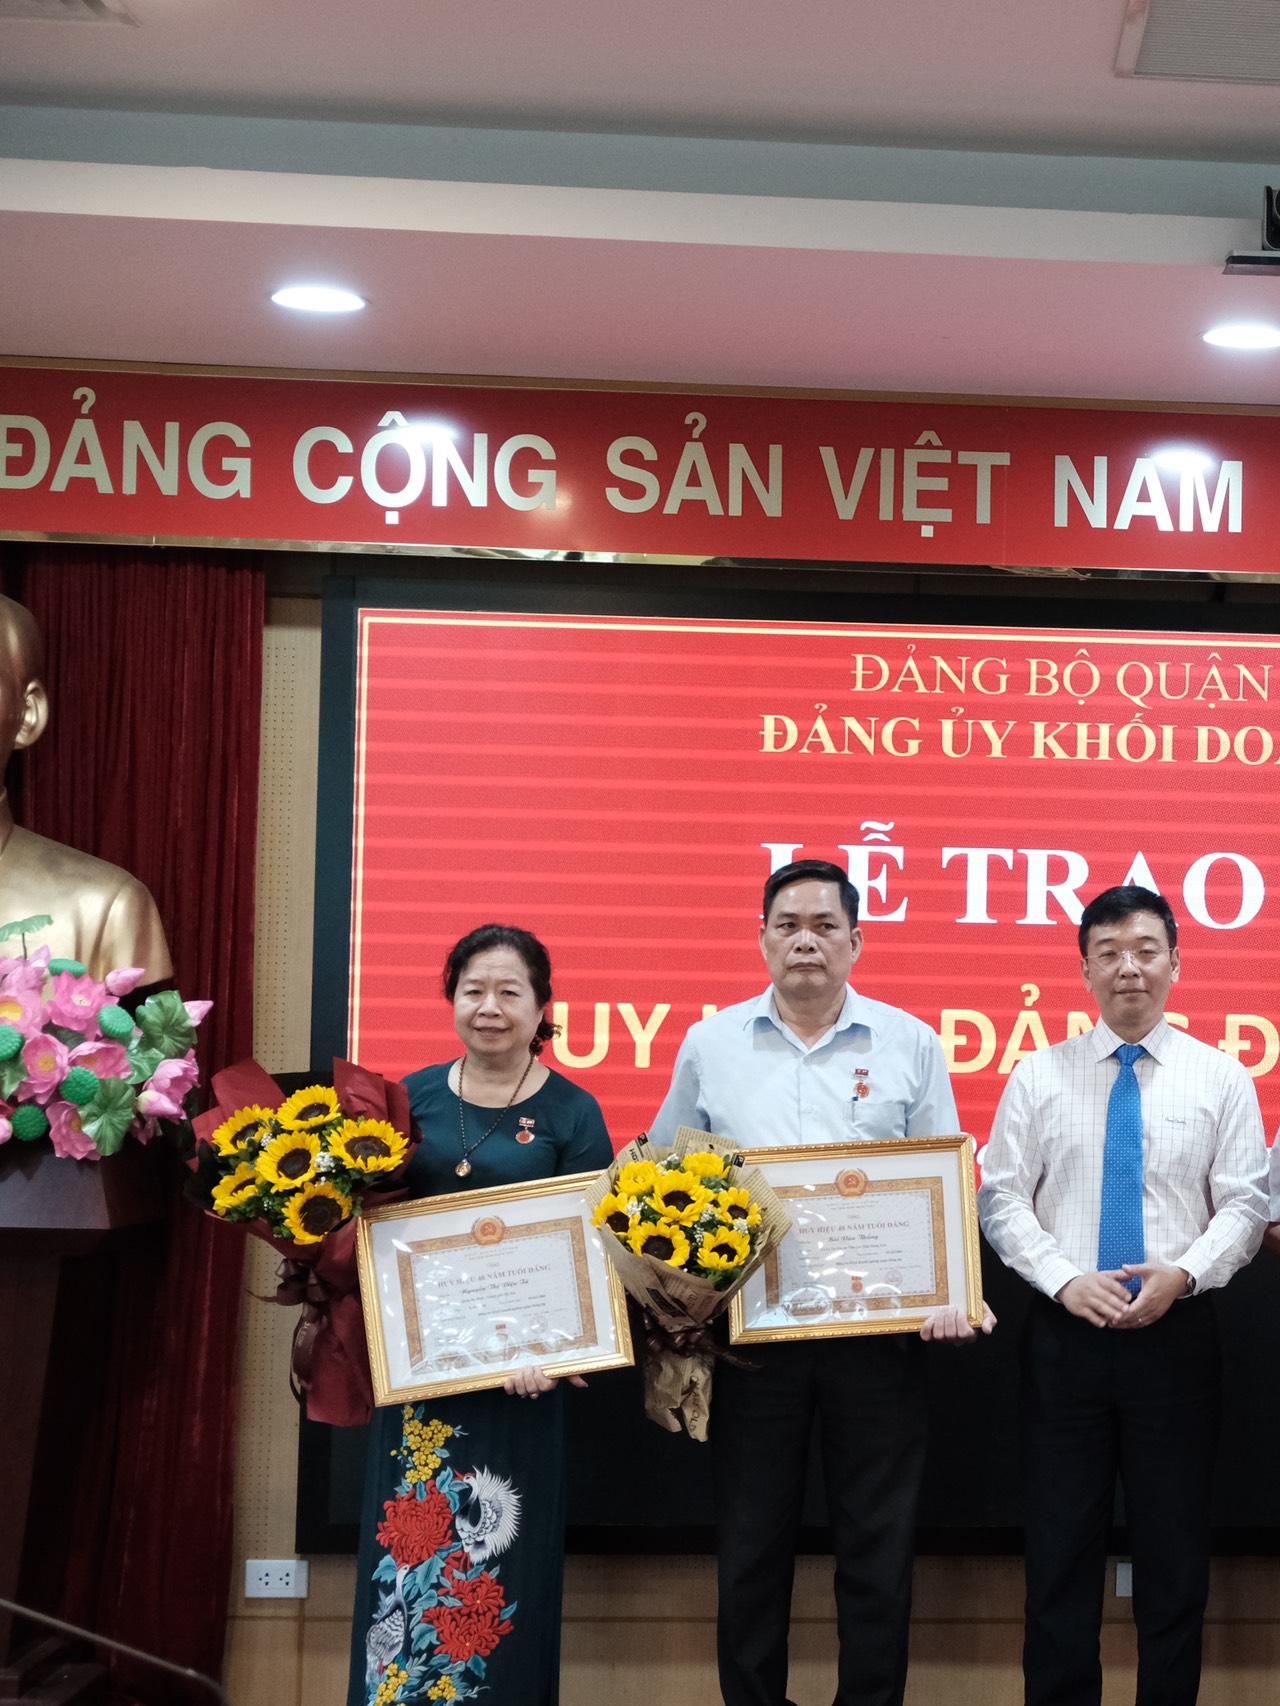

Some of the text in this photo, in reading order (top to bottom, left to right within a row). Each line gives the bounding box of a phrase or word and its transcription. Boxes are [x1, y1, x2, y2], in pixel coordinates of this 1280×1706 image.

[0, 387, 252, 498] ĐẢNG
[292, 411, 557, 524] CỘNG
[606, 412, 783, 518] SẢN
[819, 431, 1010, 538] VIỆT
[1054, 455, 1242, 533] NAM
[851, 643, 1008, 696] ĐẢNG
[1025, 648, 1103, 706] BỘ
[1115, 653, 1271, 711] QUẬN
[759, 706, 921, 757] ĐẢNG
[940, 706, 1017, 760] ỦY
[1032, 712, 1174, 764] KHỐI
[552, 1001, 671, 1068] UY
[937, 983, 1189, 1074] ĐẢ
